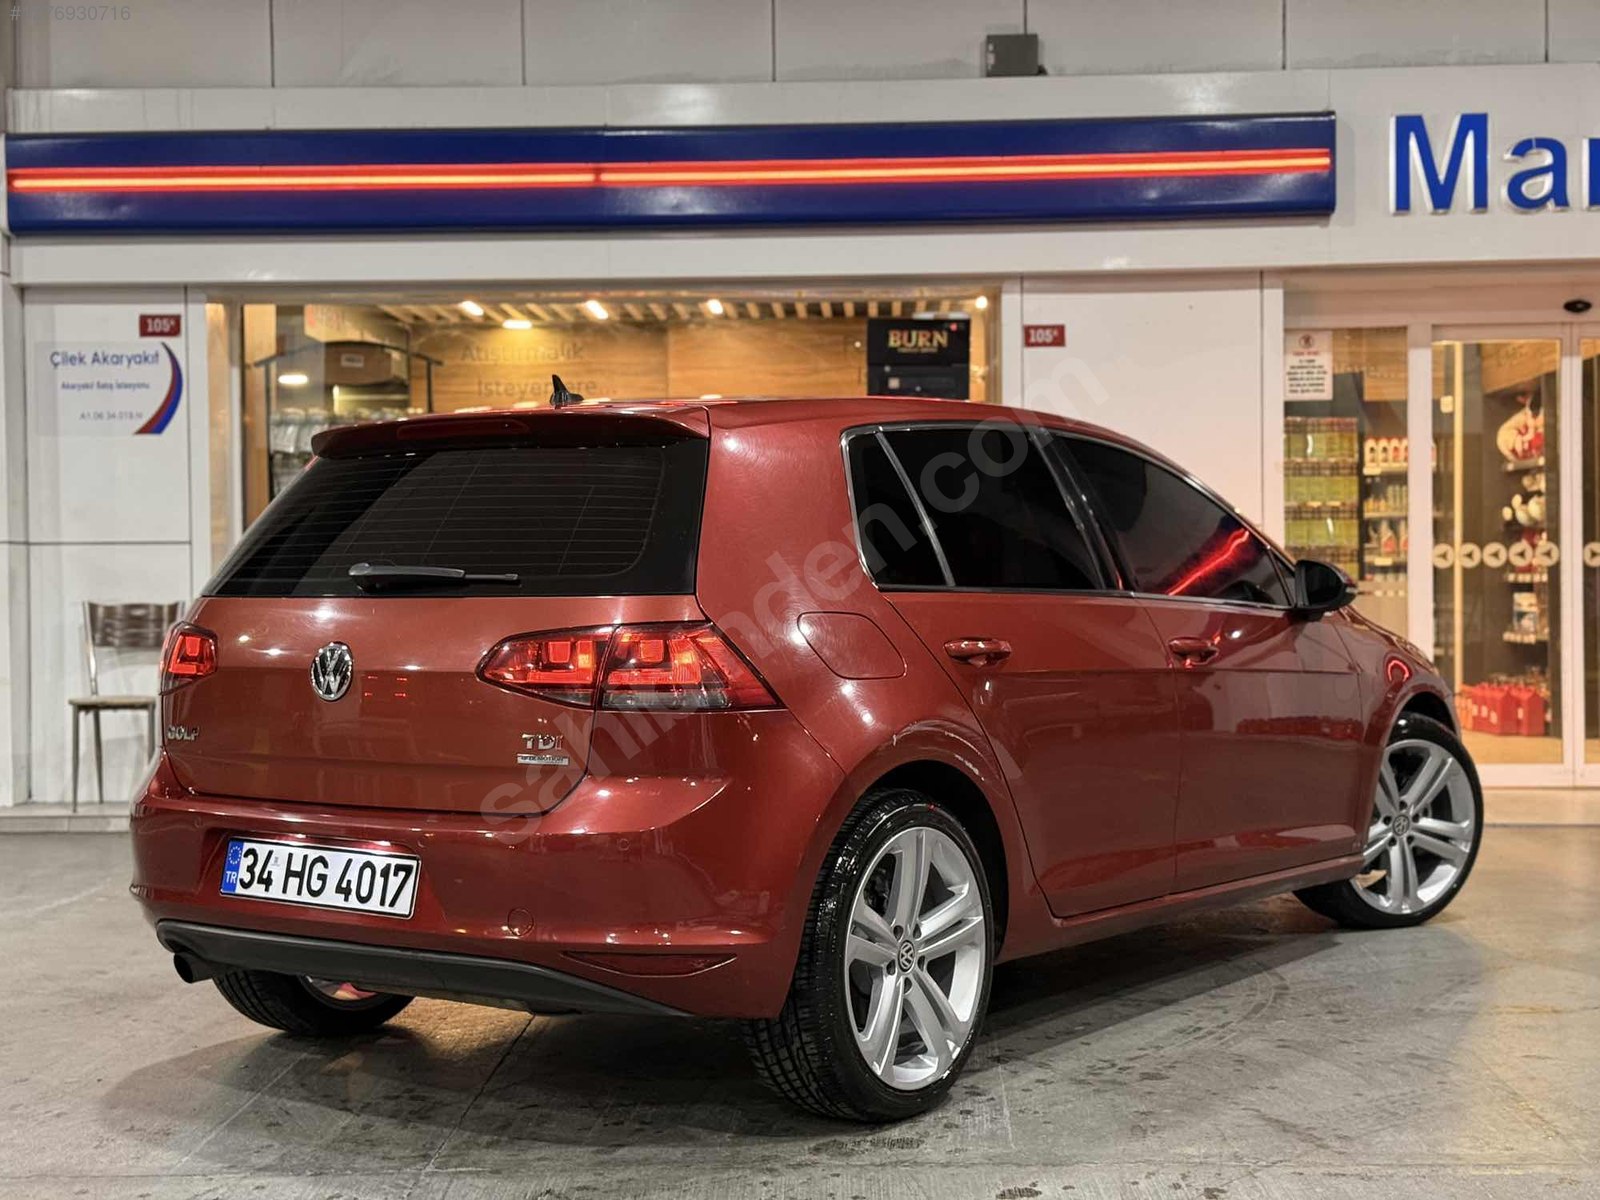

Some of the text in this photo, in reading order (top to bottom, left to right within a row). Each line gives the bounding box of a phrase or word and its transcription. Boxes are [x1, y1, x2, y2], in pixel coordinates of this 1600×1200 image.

[887, 328, 948, 348] BURN
[50, 351, 87, 370] Çilek
[521, 733, 563, 750] TDI
[225, 871, 237, 884] TR
[239, 848, 414, 908] 34 HG 4017
